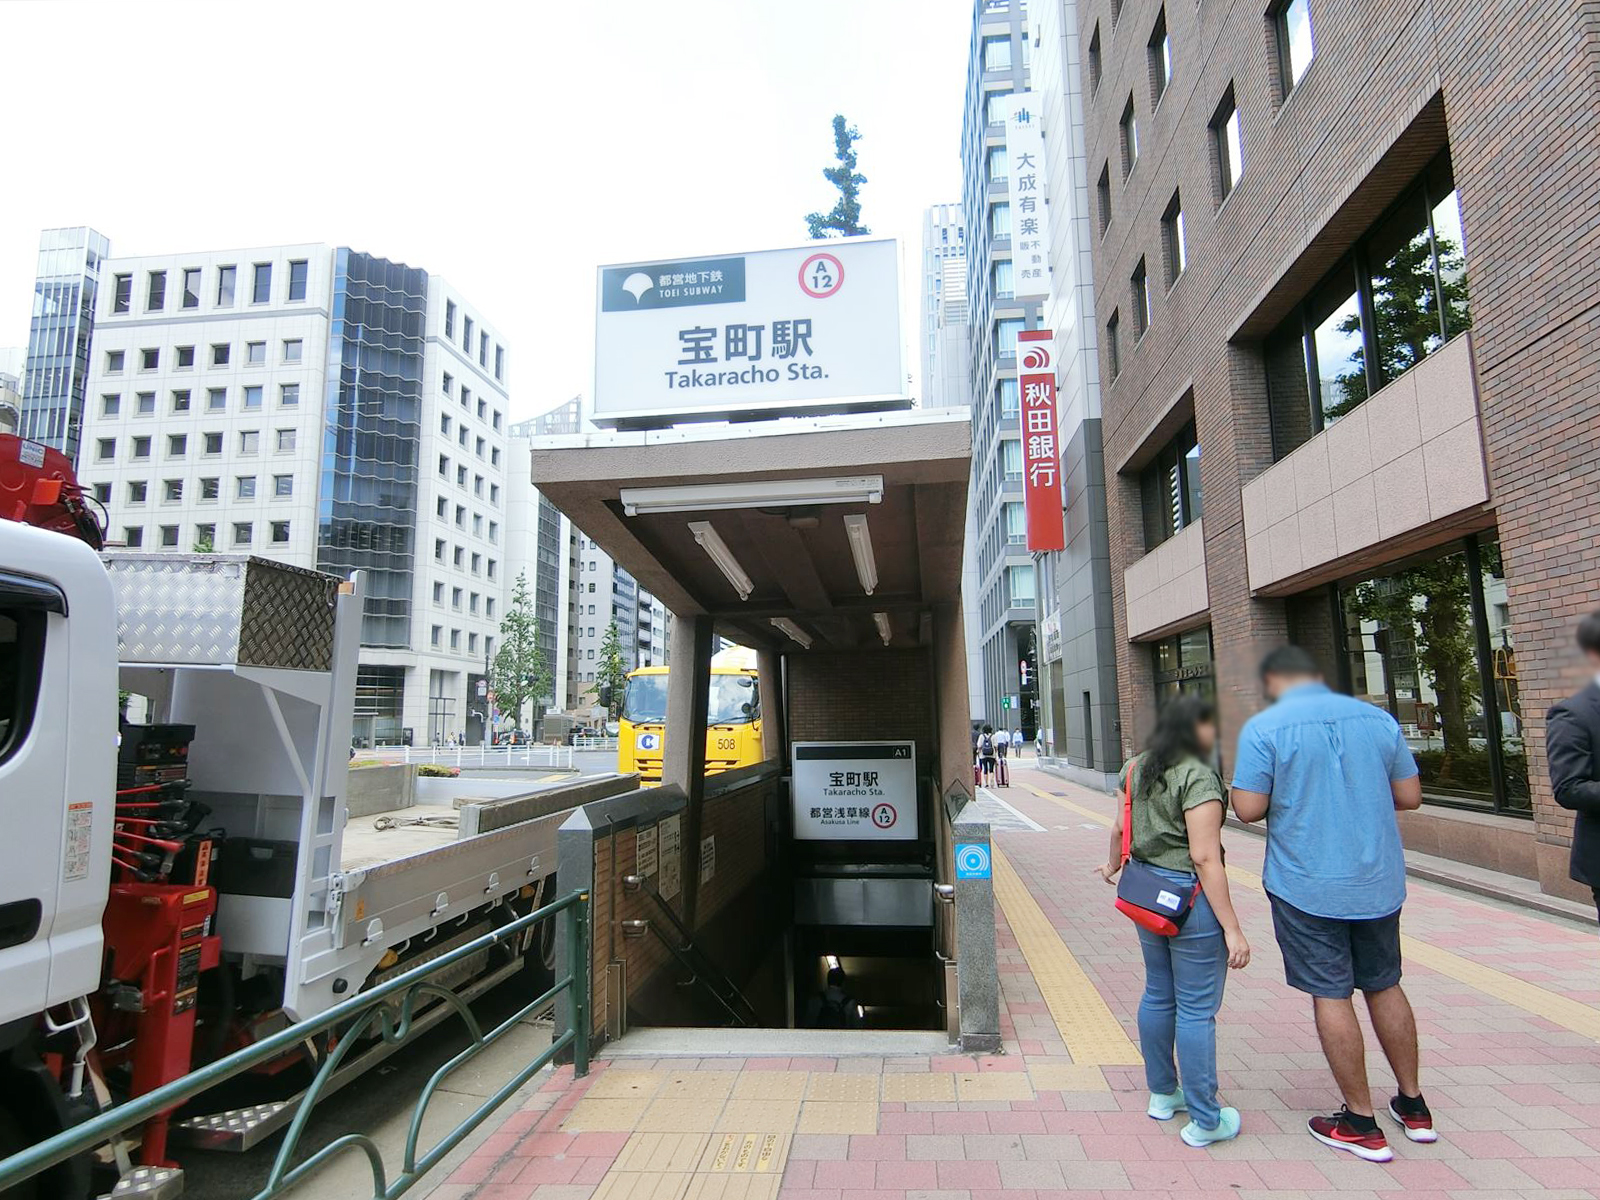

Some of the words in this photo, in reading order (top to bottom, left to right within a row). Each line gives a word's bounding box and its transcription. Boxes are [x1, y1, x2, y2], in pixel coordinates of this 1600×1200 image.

[1016, 152, 1039, 236] 大成有楽
[815, 261, 828, 274] A
[659, 270, 723, 286] 都営地下鉄
[812, 275, 832, 289] 12
[659, 288, 680, 299] TOEI
[684, 286, 723, 297] SUBWAY
[677, 318, 814, 366] 宝町駅
[665, 364, 780, 389] Takaracho
[787, 362, 830, 382] Sta.
[1024, 382, 1056, 488] 秋田銀行
[717, 738, 736, 750] 508
[828, 771, 879, 787] 宝町駅
[823, 787, 867, 796] Takaracho
[868, 788, 886, 796] Sta.
[809, 807, 871, 819] 都営浅草線
[880, 807, 888, 815] A
[878, 815, 890, 823] 12
